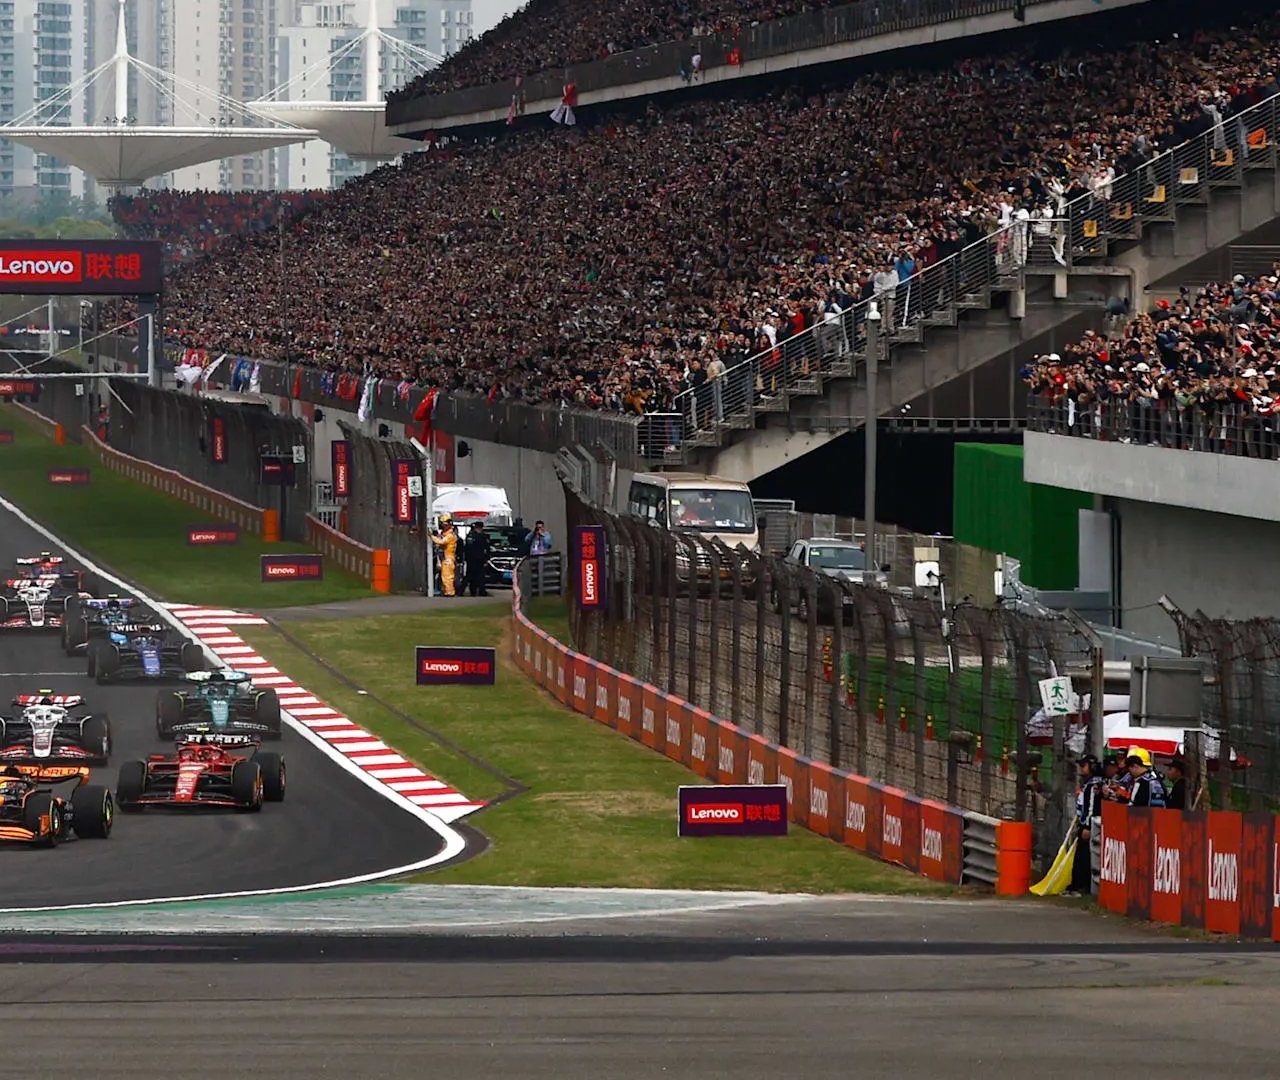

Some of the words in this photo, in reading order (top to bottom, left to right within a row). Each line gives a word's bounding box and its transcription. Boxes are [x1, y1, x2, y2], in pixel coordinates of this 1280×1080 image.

[85, 253, 141, 280] 联想
[400, 487, 408, 518] Lenovo
[268, 566, 295, 575] Lenovo
[584, 563, 594, 601] Lenovo
[425, 662, 460, 672] Lenovo
[691, 807, 740, 819] Lenovo
[745, 805, 781, 821] 联想
[1100, 824, 1127, 885] Lenovo
[1154, 833, 1181, 895] Lenovo
[1208, 838, 1238, 903] Lenovo
